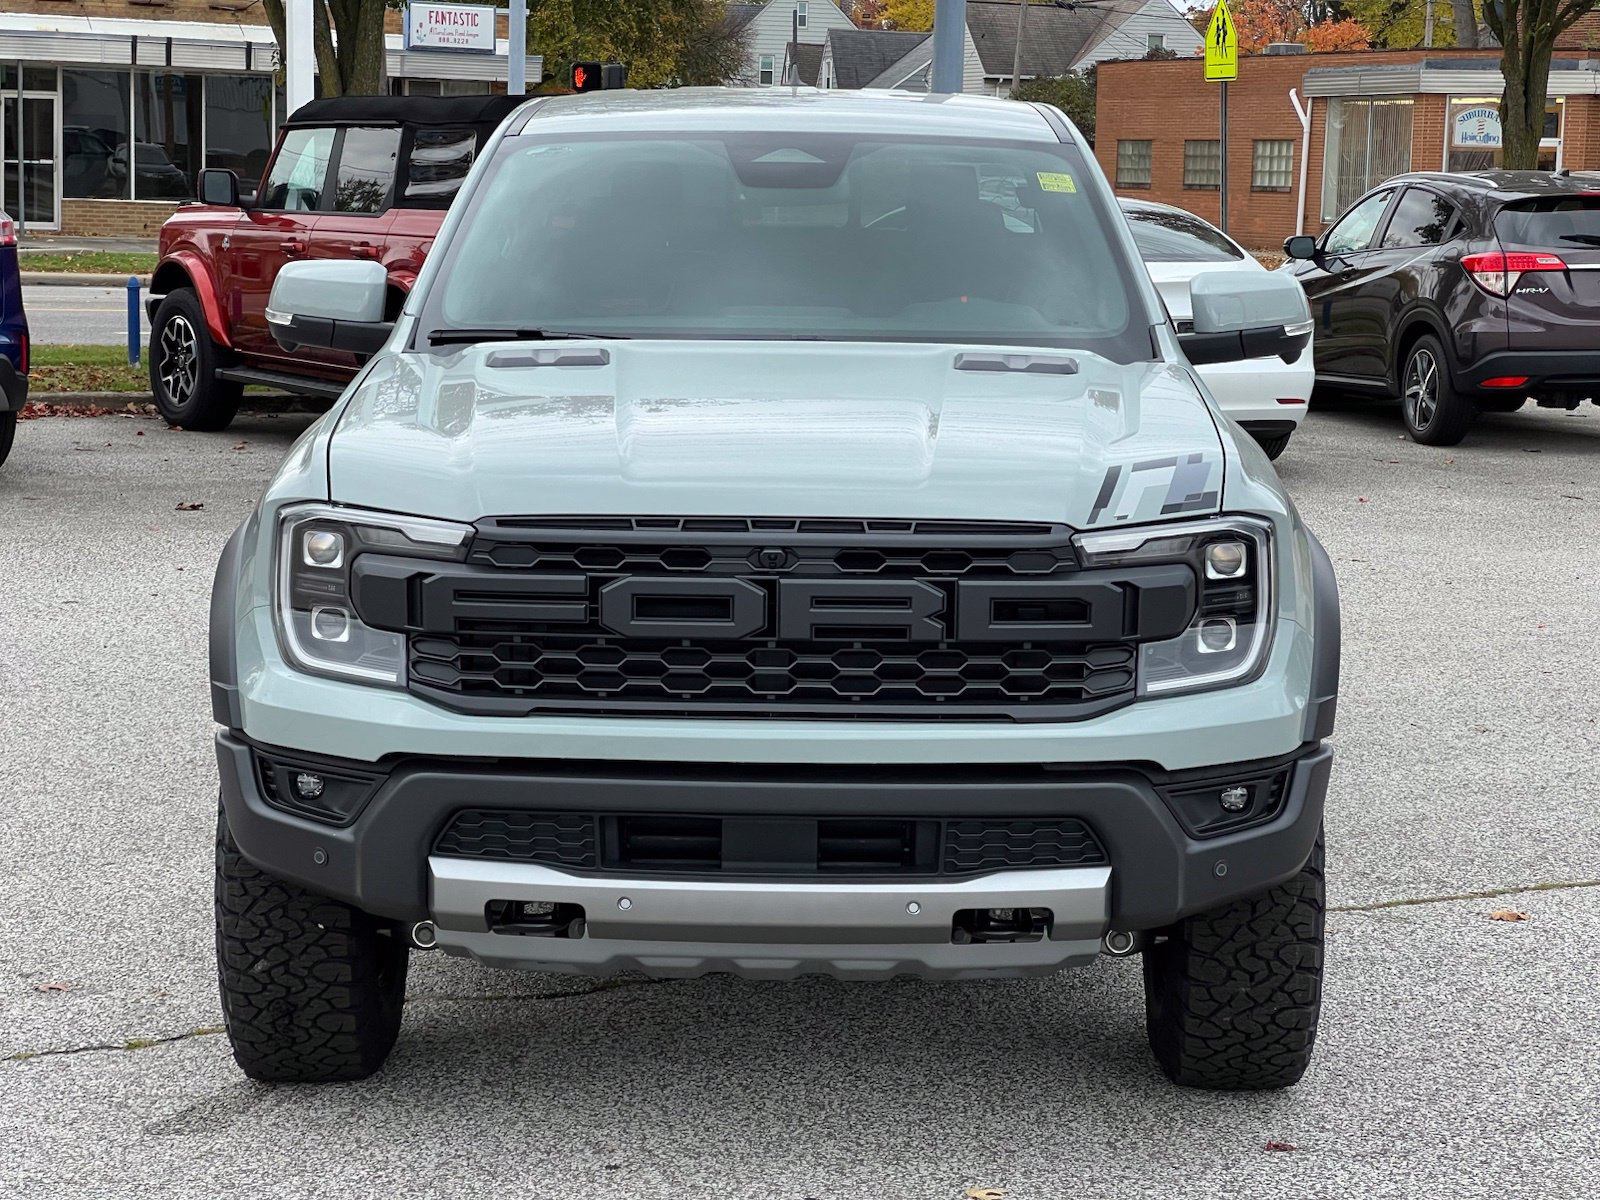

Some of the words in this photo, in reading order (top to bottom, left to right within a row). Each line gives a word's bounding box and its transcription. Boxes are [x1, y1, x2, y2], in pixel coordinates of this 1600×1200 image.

[429, 10, 479, 27] FANTASTIC
[1457, 109, 1500, 125] SUBURBA
[1515, 287, 1549, 295] HR-V
[420, 572, 1124, 643] FORD
